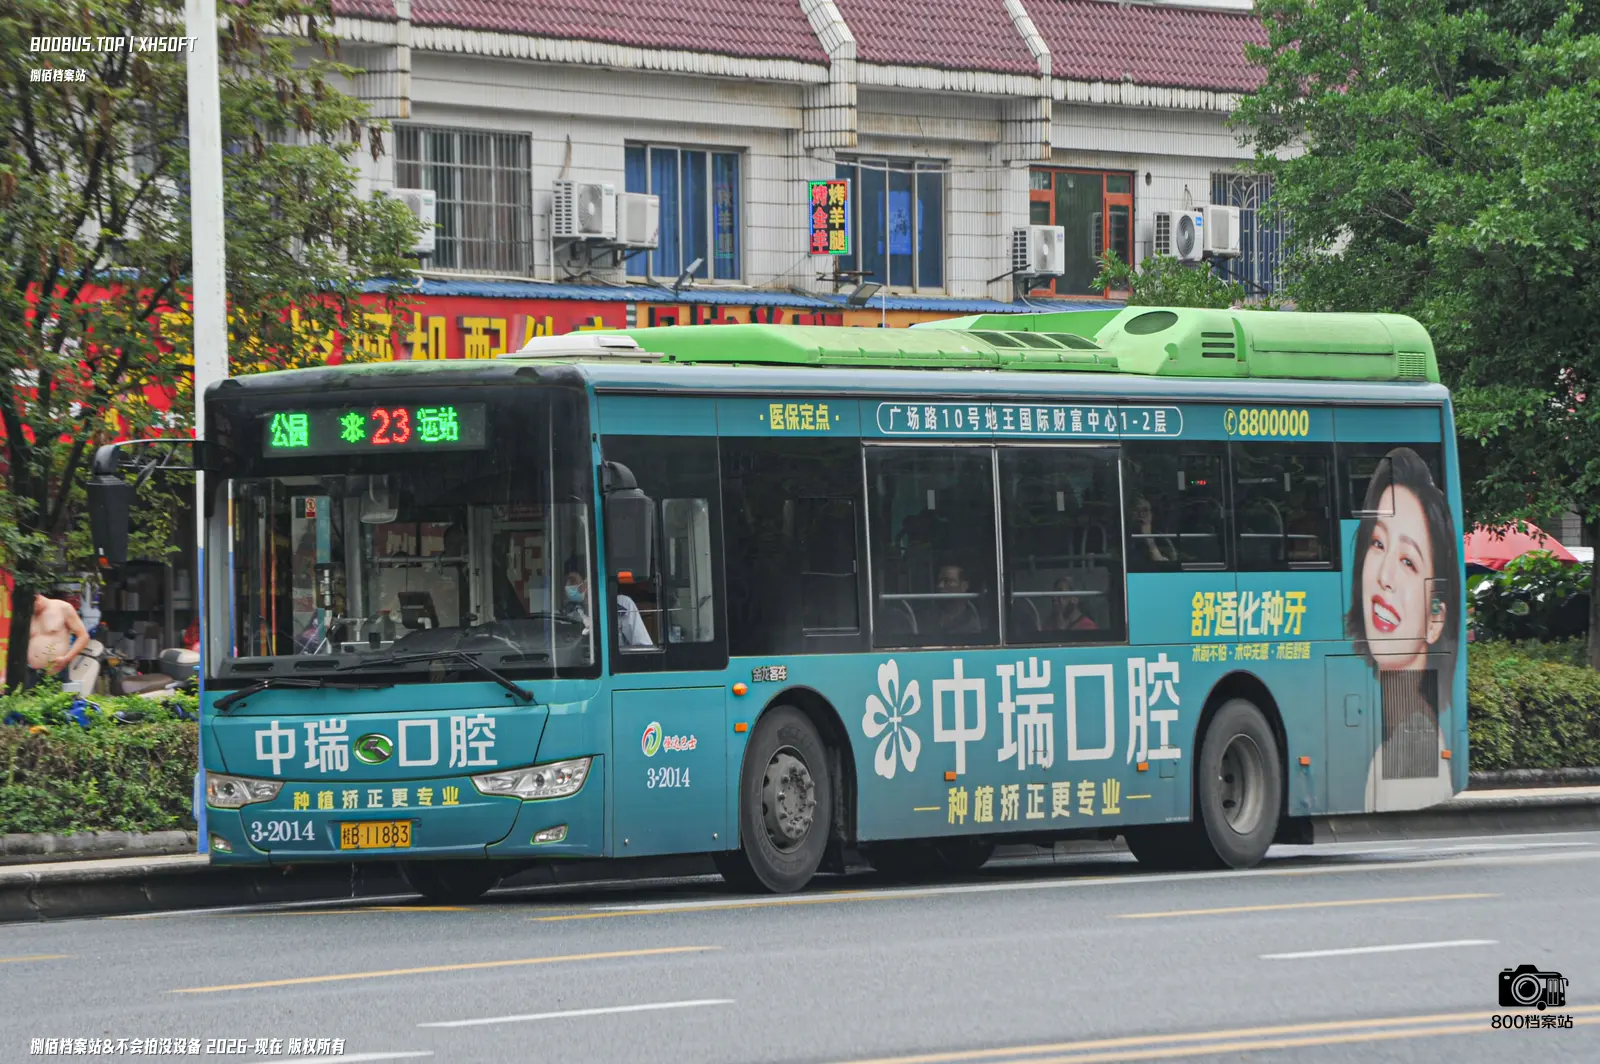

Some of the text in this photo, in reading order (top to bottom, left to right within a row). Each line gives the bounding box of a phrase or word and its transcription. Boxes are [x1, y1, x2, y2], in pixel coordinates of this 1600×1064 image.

[812, 184, 828, 252] 烤全羊
[828, 184, 845, 251] 烤羊腿
[371, 408, 411, 444] 23
[889, 406, 1167, 433] 广场路10号地王国际财富中心1-2层
[1238, 408, 1310, 436] 8800000
[1191, 590, 1307, 636] 舒适化种牙
[752, 665, 787, 682] 金龙客车
[932, 653, 1182, 775] 中瑞口腔
[647, 767, 690, 788] 3-2014
[293, 786, 461, 811] 种植矫正更专业
[948, 778, 1121, 825] 种植矫正更专业
[251, 820, 315, 842] 3-2014
